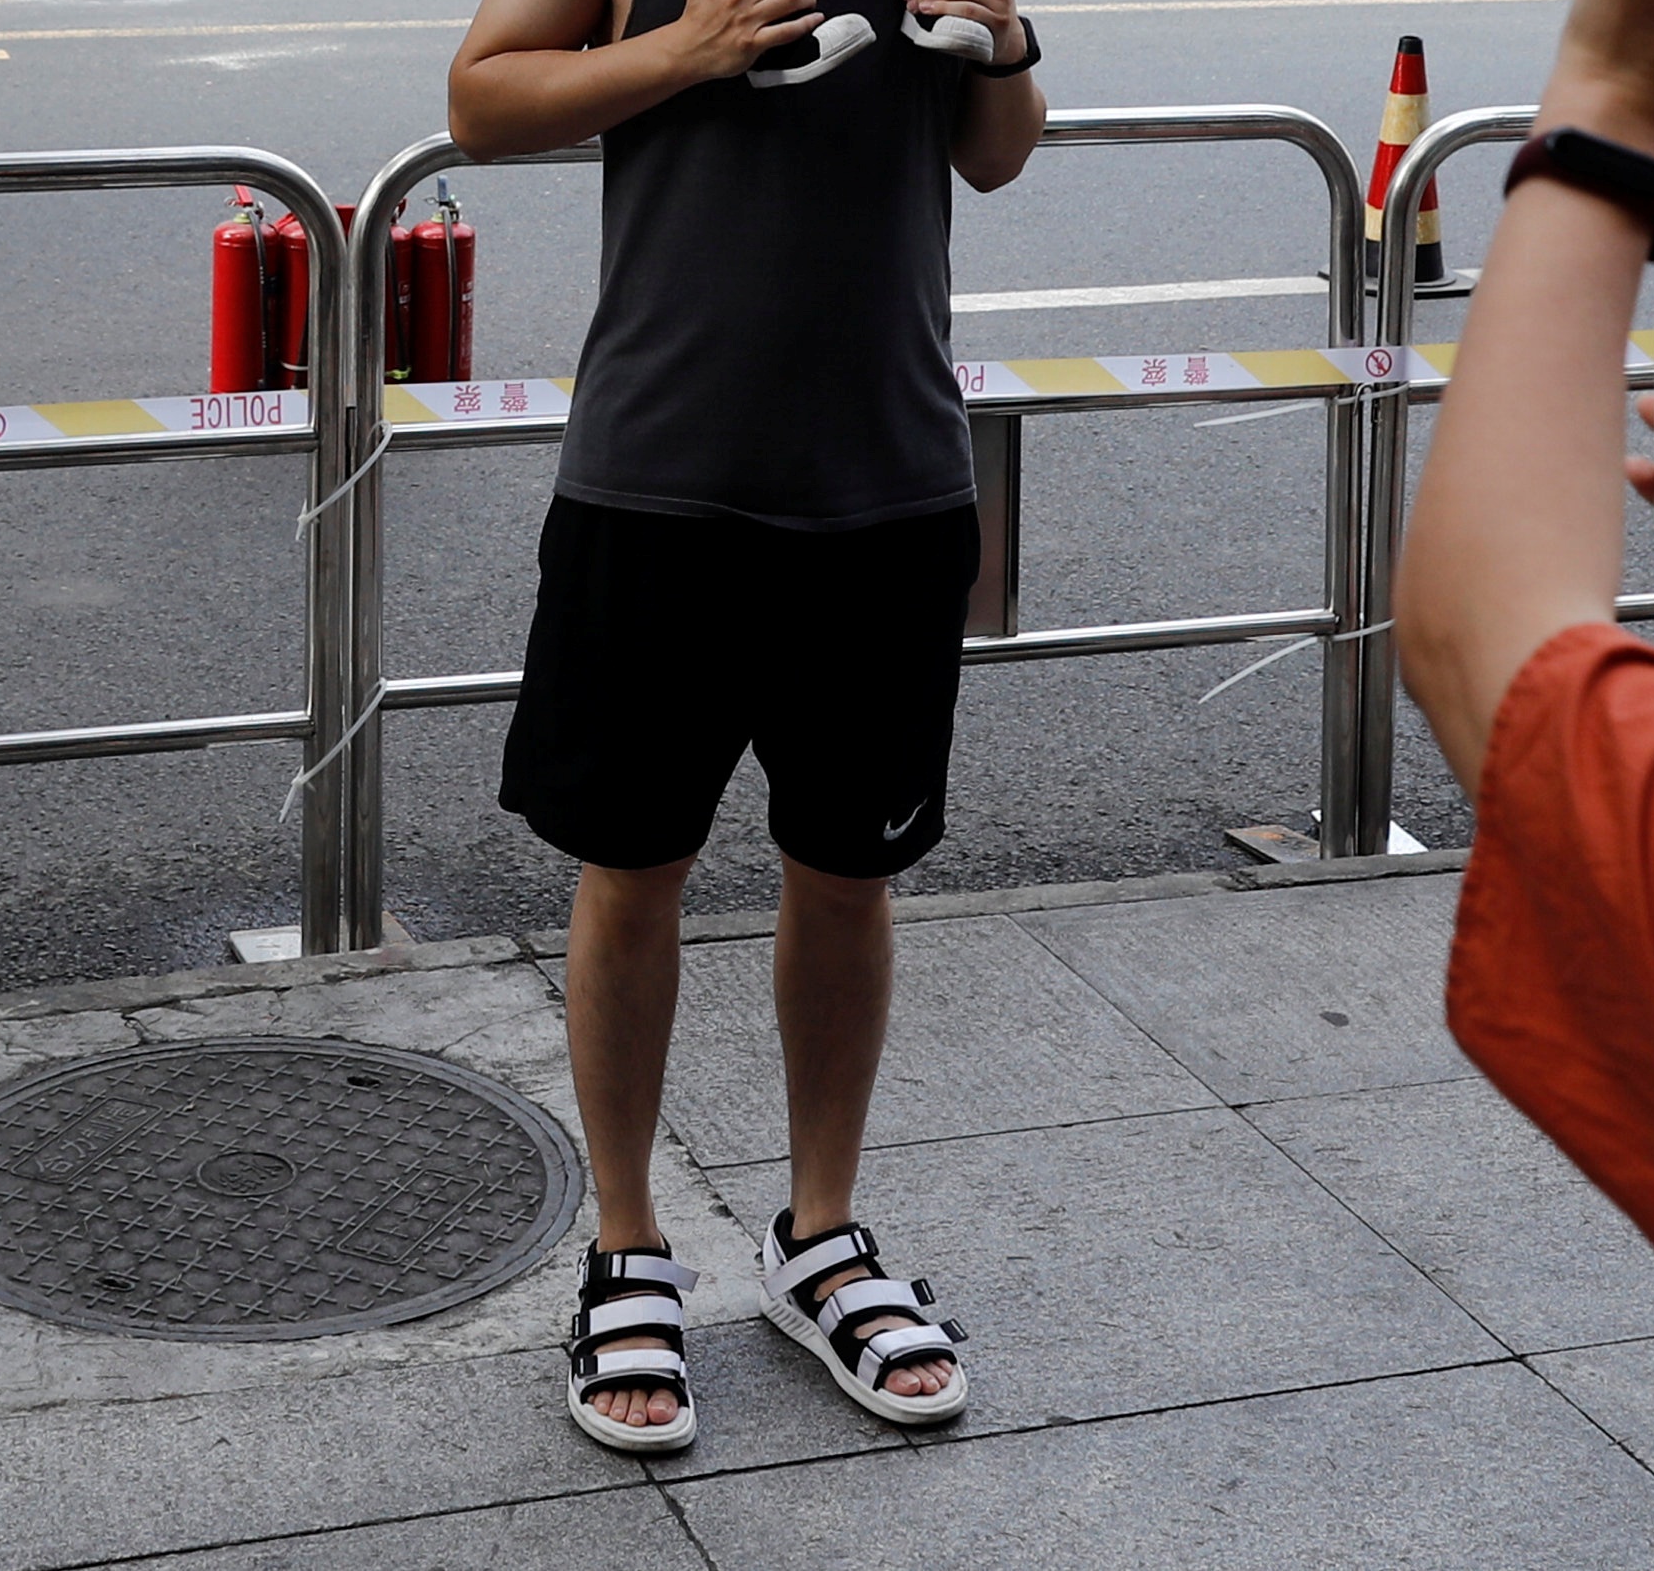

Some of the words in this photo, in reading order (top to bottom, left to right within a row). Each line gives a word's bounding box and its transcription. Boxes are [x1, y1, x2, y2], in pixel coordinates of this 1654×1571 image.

[955, 364, 985, 393] PO
[1141, 356, 1210, 386] 警察
[190, 394, 282, 429] POLICE
[453, 382, 529, 415] 警察
